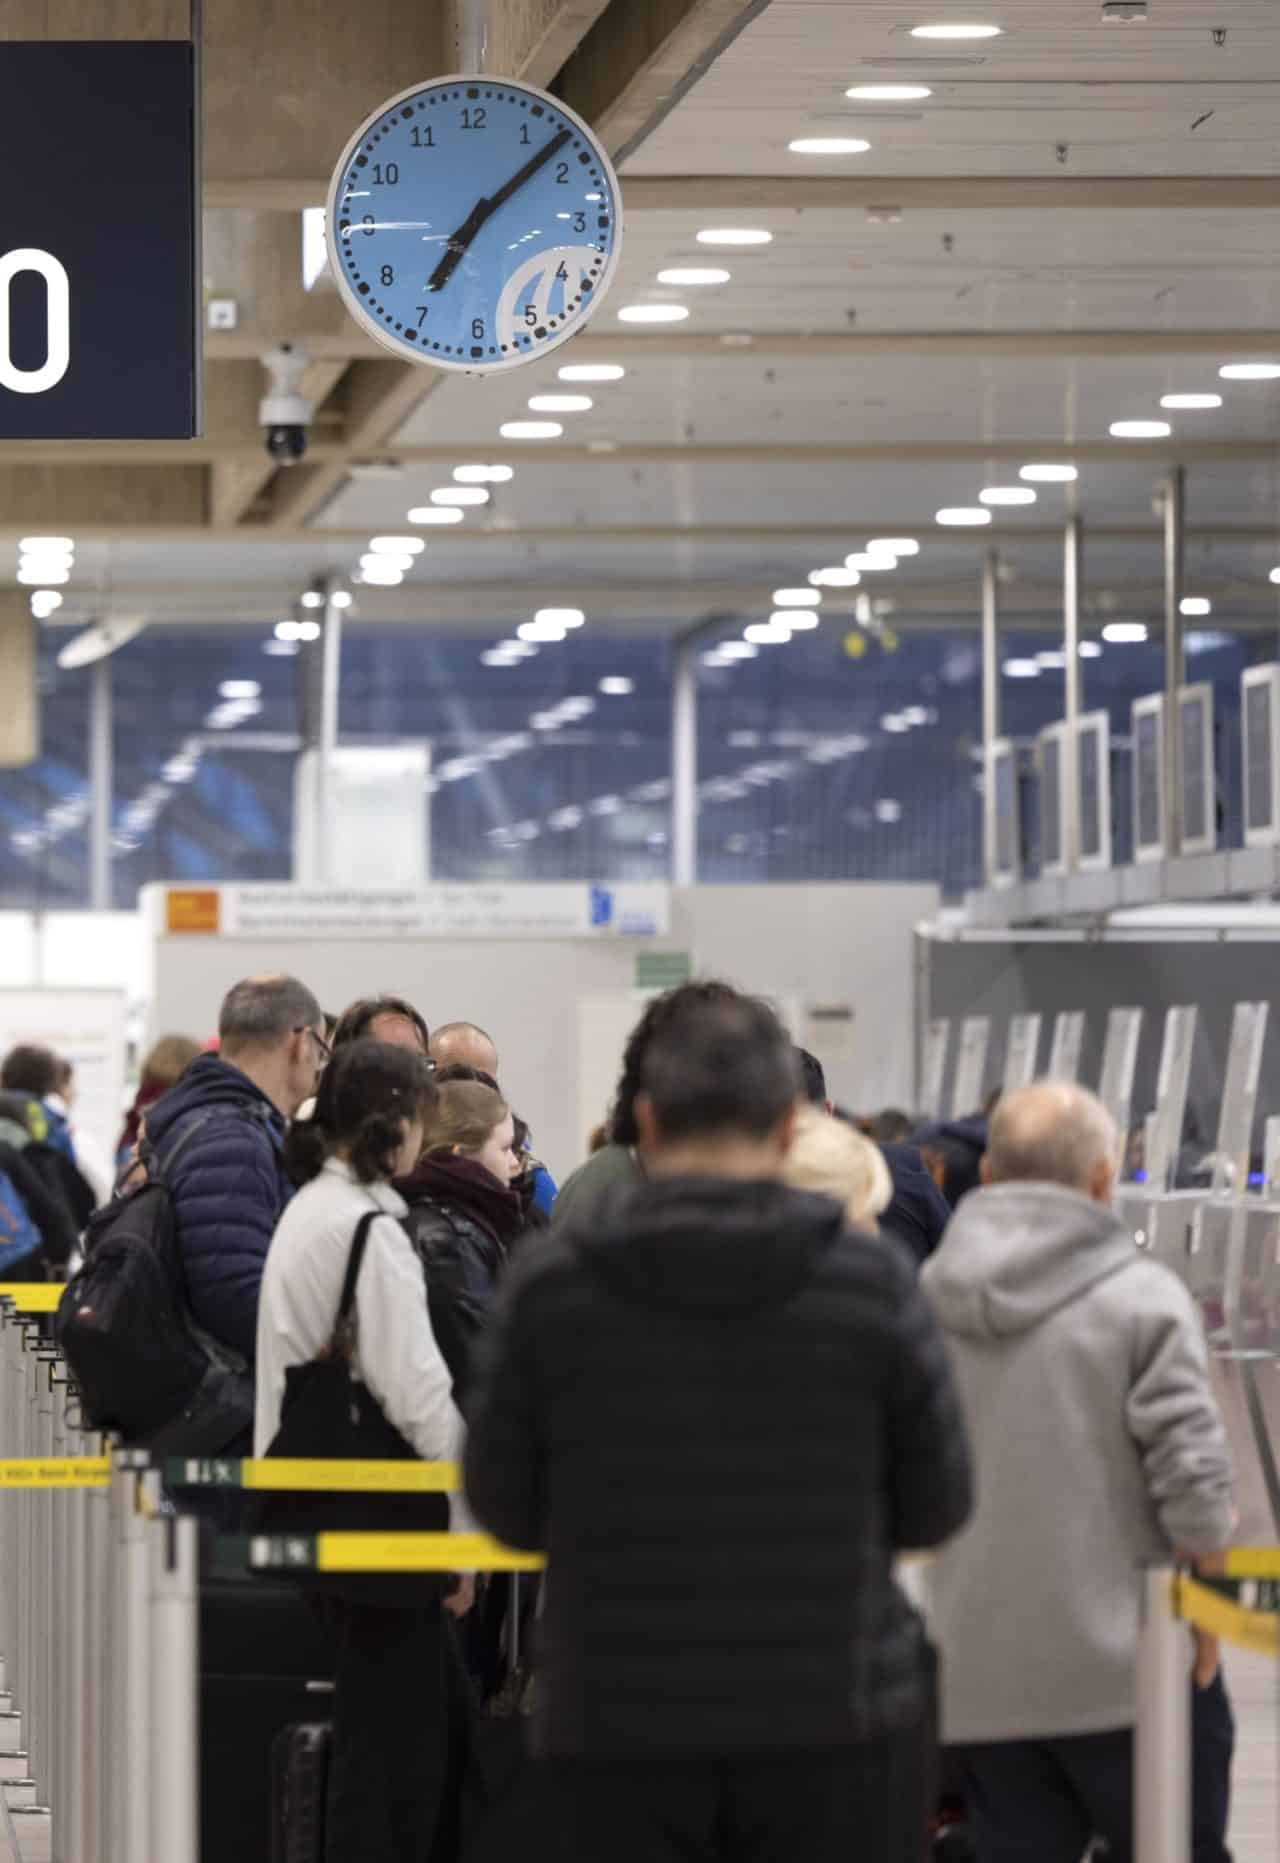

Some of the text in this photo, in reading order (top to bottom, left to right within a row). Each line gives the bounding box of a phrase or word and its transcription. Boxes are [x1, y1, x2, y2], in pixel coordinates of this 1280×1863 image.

[460, 108, 486, 129] 12
[410, 126, 436, 147] 11
[520, 125, 531, 144] 1
[372, 163, 399, 184] 10
[556, 163, 569, 184] 2
[573, 212, 586, 232] 3
[381, 265, 394, 287] 8
[555, 261, 568, 281] 4
[416, 307, 428, 327] 7
[525, 305, 537, 326] 5
[472, 319, 484, 339] 6
